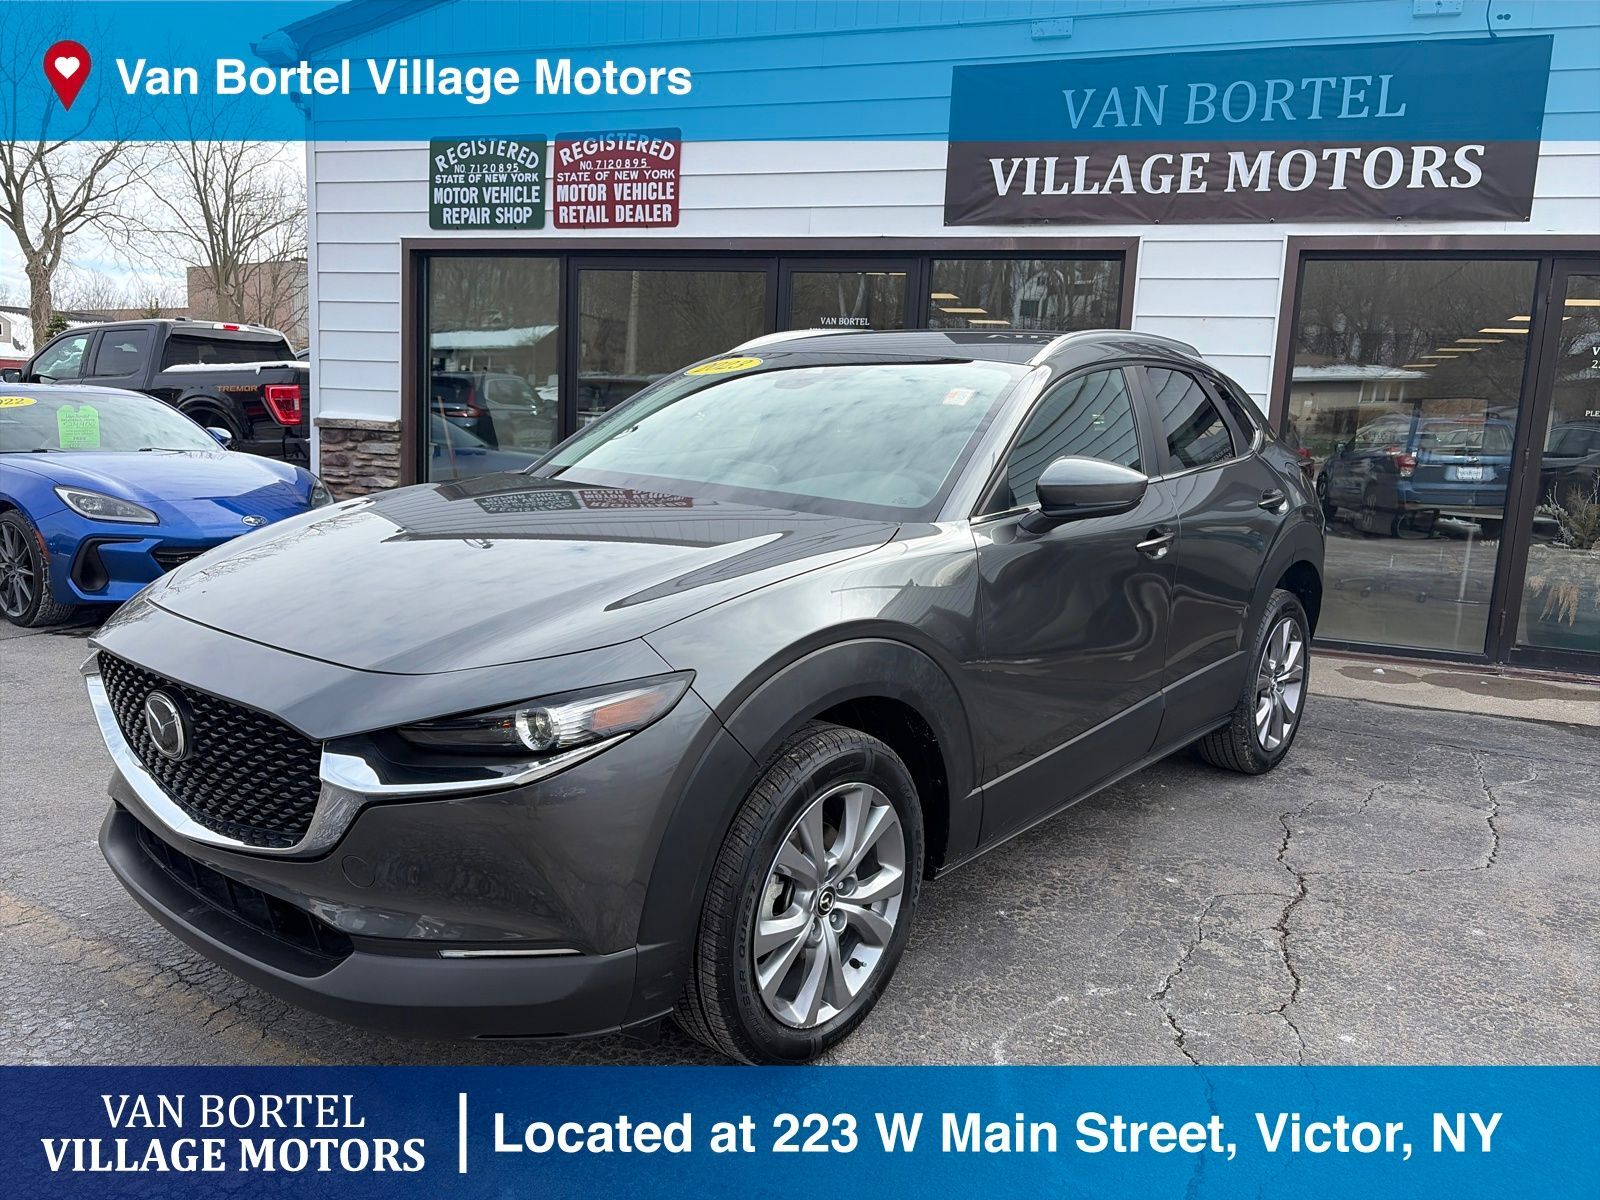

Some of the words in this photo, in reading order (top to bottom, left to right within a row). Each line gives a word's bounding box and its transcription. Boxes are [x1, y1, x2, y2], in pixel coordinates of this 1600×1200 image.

[1062, 84, 1169, 130] VAN
[1184, 74, 1408, 126] BORTEL
[434, 137, 540, 172] REGISTERED
[559, 132, 675, 166] REGISTERED
[470, 163, 519, 173] 7120895
[595, 158, 648, 169] 7120895
[988, 152, 1210, 197] VILLAGE
[1223, 144, 1486, 194] MOTORS
[435, 174, 465, 184] STATE
[468, 174, 482, 184] OF
[485, 173, 508, 183] NEW
[511, 172, 539, 183] YORK
[557, 172, 591, 183] STATE
[595, 171, 610, 181] OF
[614, 170, 639, 181] NEW
[643, 169, 676, 180] YORK
[434, 187, 479, 205] MOTOR
[482, 185, 541, 204] VEHICLE
[557, 183, 607, 202] MOTOR
[613, 181, 675, 201] VEHICLE
[443, 207, 491, 225] REPAIR
[495, 206, 533, 224] SHOP
[559, 205, 610, 224] RETAIL
[615, 203, 672, 223] DEALER
[820, 316, 837, 326] VAN
[838, 317, 870, 326] BORTEL
